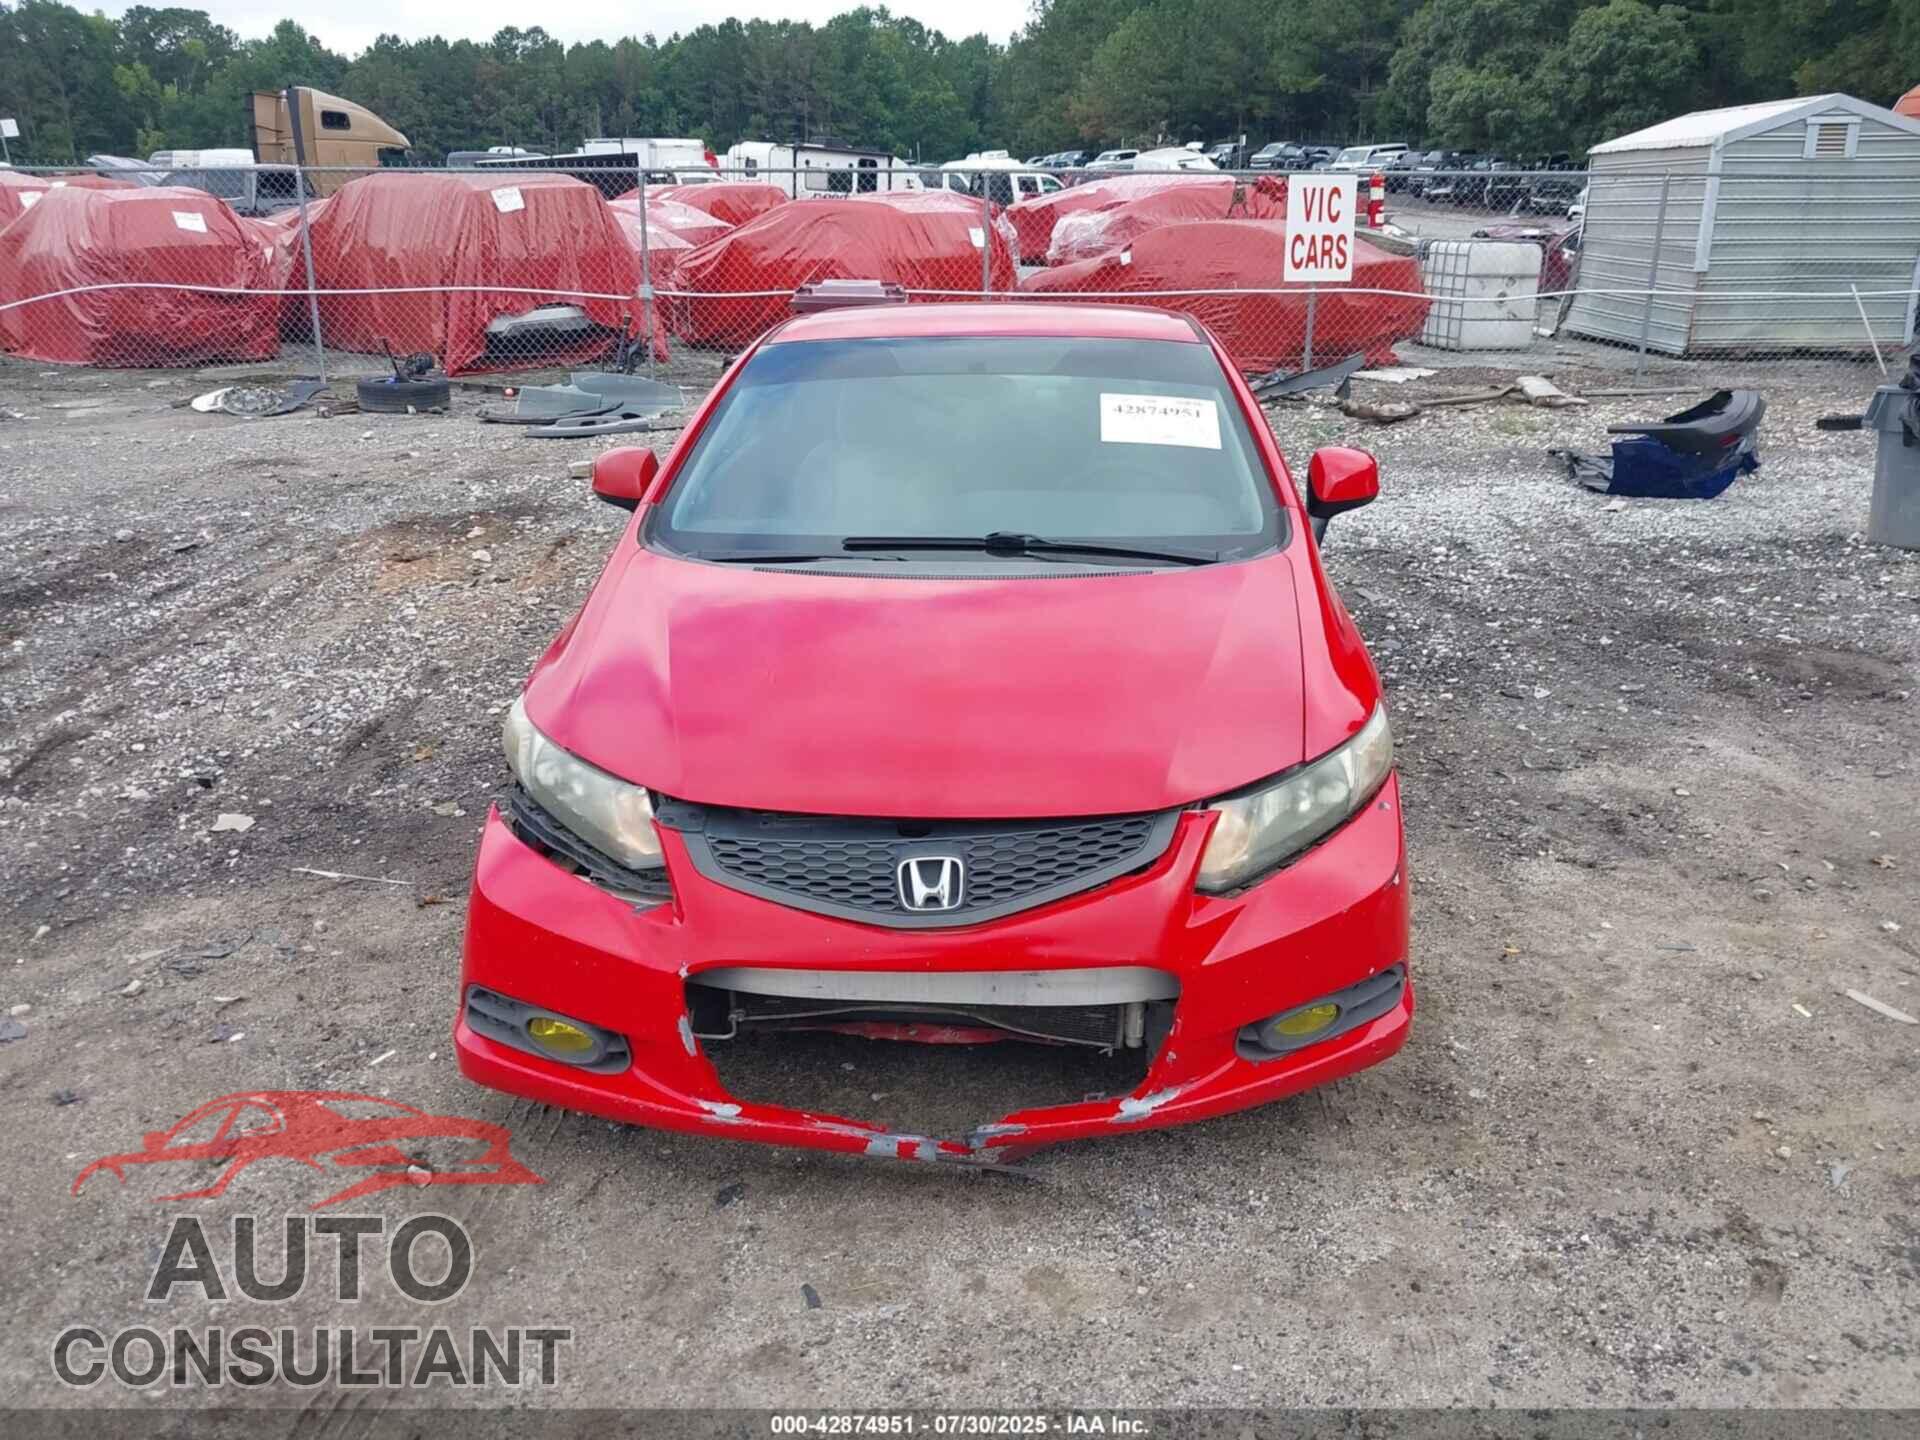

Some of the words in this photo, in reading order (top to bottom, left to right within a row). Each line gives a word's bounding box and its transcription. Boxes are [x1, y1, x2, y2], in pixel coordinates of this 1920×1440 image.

[1303, 186, 1342, 223] VIC
[1291, 233, 1348, 270] CARS
[1112, 403, 1201, 418] 42874951
